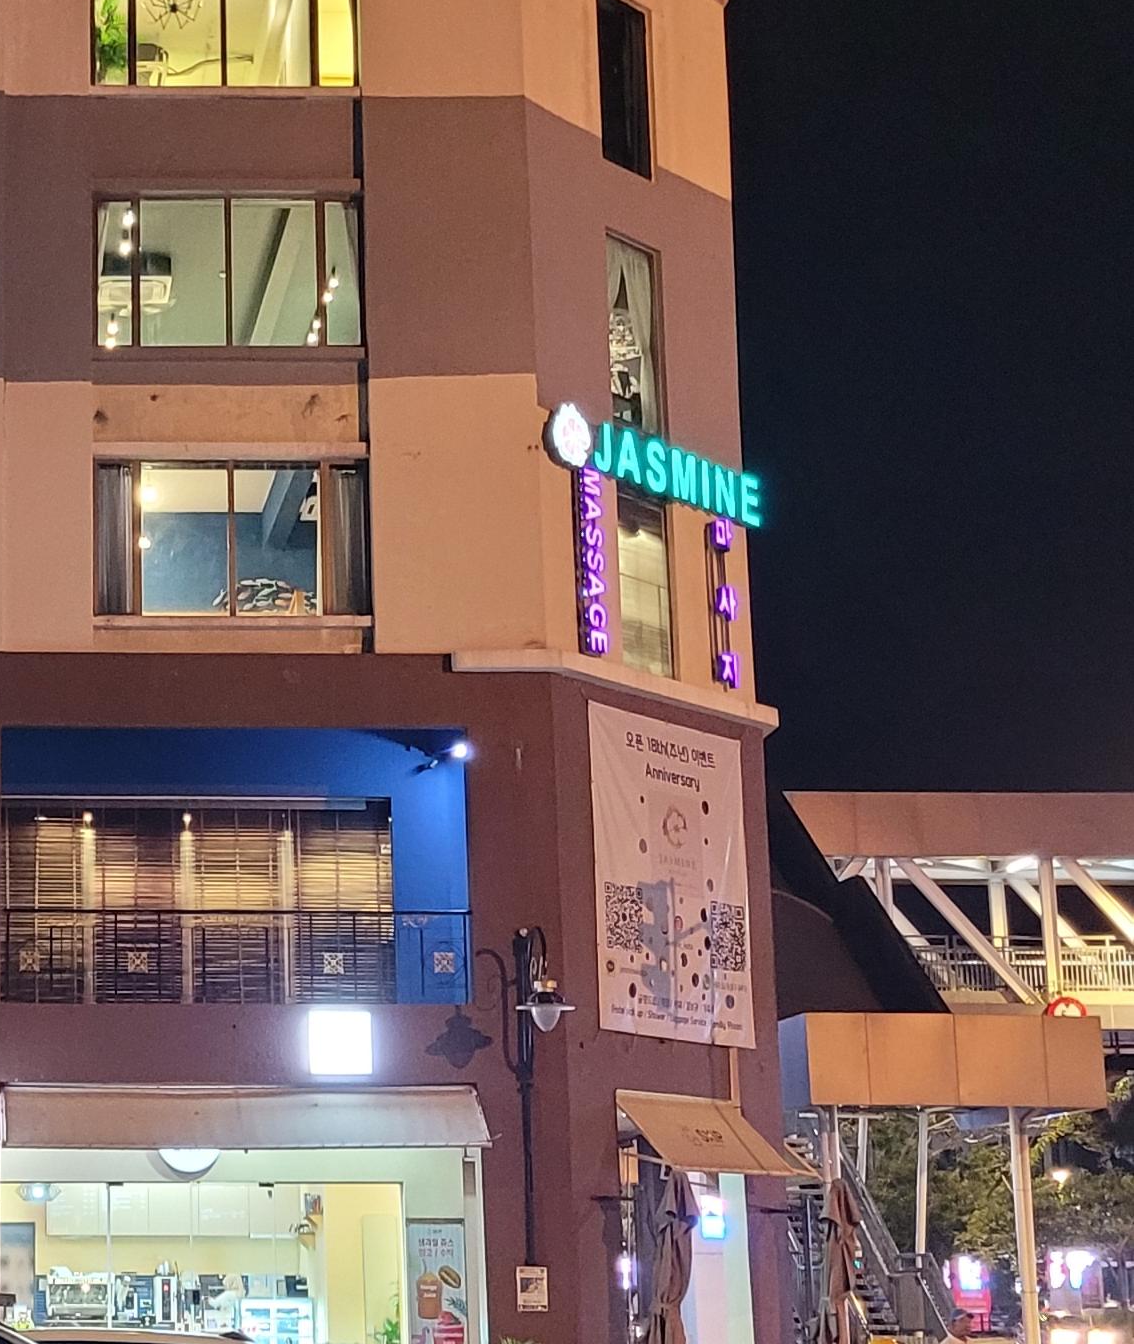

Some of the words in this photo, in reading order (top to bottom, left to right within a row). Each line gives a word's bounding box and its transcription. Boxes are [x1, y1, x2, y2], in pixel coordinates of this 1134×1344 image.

[594, 422, 762, 528] JASMINE
[583, 467, 609, 654] MASSAGE
[626, 731, 644, 752] 오픈
[645, 761, 701, 793] Anniversary
